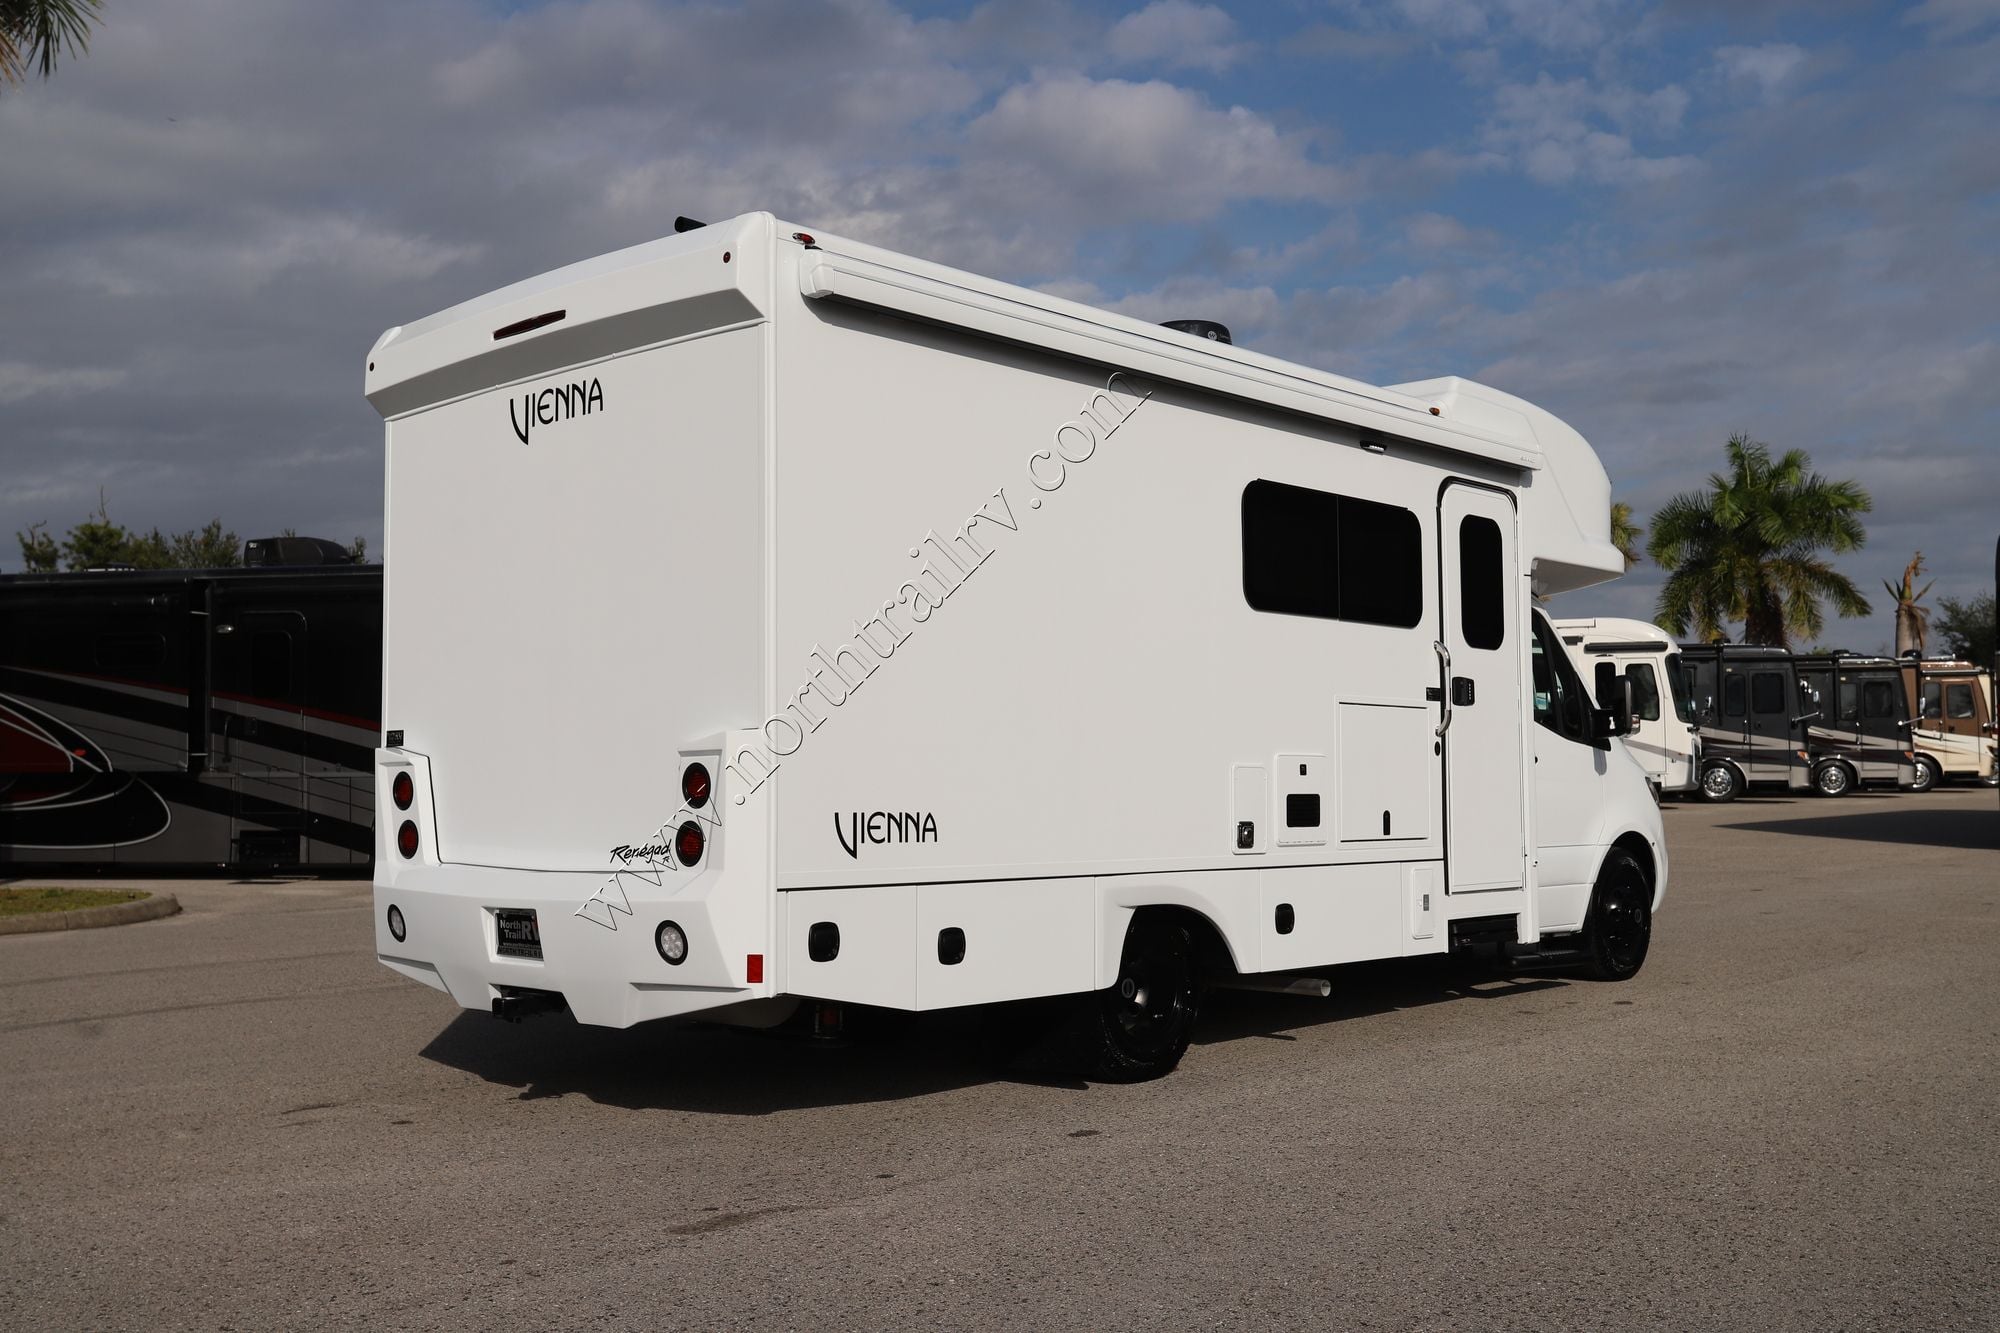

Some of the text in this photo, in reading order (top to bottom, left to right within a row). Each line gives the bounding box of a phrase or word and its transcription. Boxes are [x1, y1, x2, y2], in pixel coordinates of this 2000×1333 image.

[509, 377, 604, 446] VIENNA
[834, 811, 938, 860] VIENNA
[500, 919, 521, 929] North
[504, 929, 522, 940] Trail
